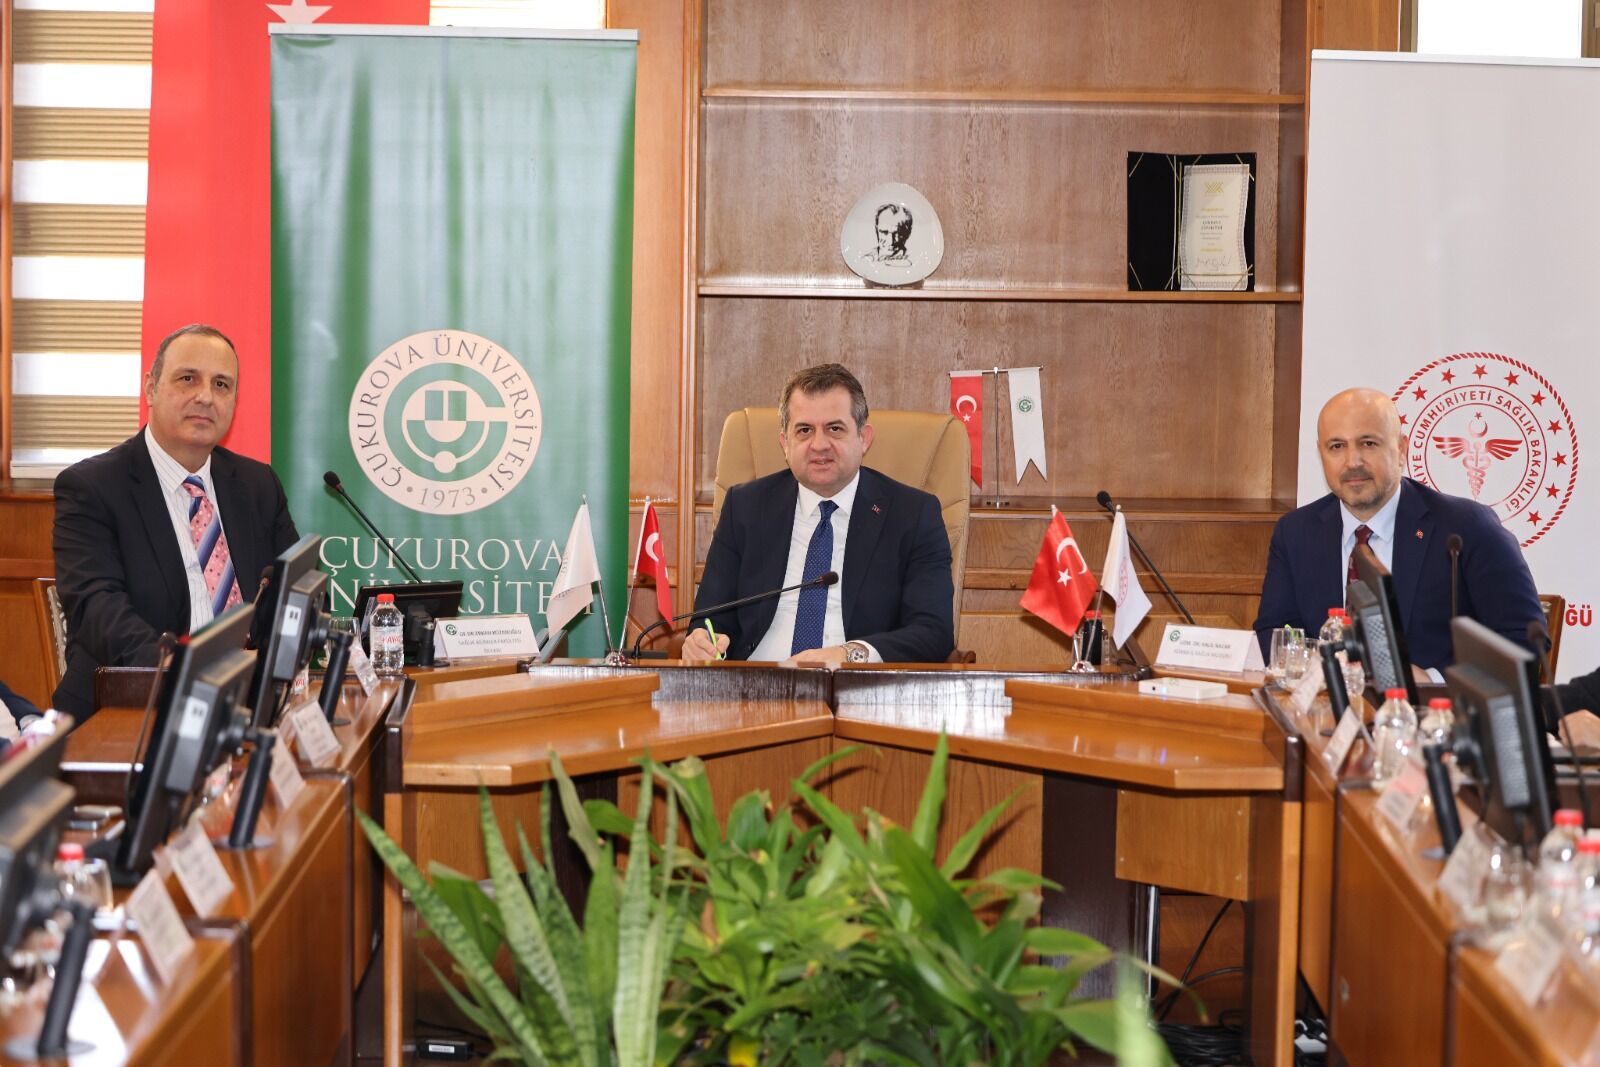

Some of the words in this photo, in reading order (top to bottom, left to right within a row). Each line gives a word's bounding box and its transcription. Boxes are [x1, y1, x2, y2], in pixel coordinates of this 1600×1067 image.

[357, 344, 424, 488] ÇUKUROVA
[432, 333, 538, 492] ÜNİVERSİTESİ
[1495, 394, 1537, 436] SAĞLIK
[1505, 439, 1542, 512] BAKANLIĞI
[418, 486, 476, 509] 1973
[318, 536, 562, 576] ÇUKUROVA
